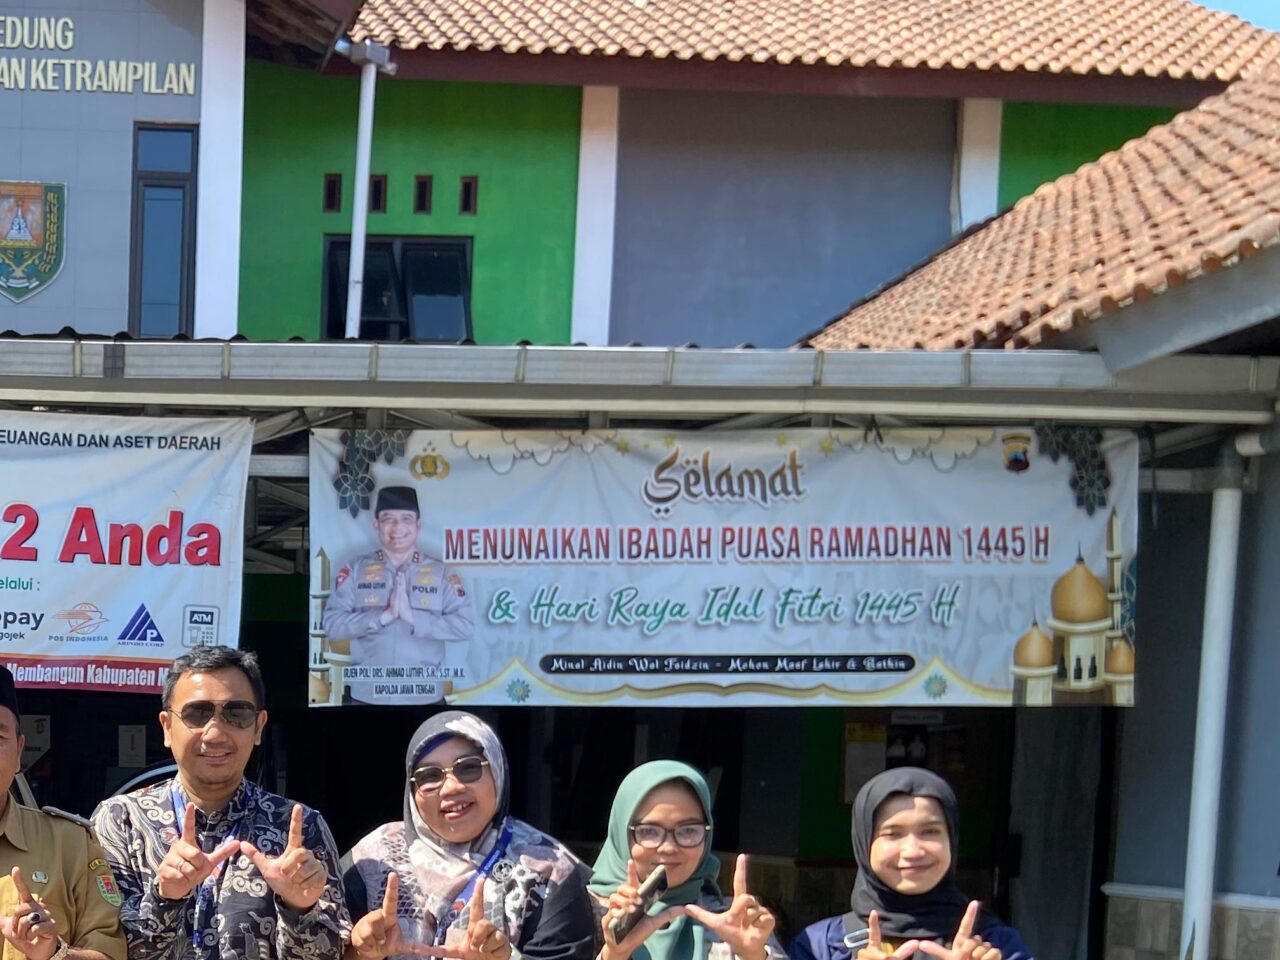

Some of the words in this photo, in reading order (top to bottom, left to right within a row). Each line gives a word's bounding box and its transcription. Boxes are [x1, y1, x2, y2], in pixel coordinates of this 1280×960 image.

[30, 58, 196, 95] KETRAMPILAN
[77, 433, 109, 449] DAN
[113, 435, 153, 449] ASET
[157, 436, 221, 450] DAERAH
[57, 506, 221, 567] Anda
[444, 527, 610, 562] MENUNAIKAN
[619, 528, 712, 561] IBADAH
[721, 526, 801, 560] PUASA
[809, 526, 952, 559] RAMADHAN
[962, 526, 1026, 558] 1445
[1032, 526, 1050, 558] H
[412, 585, 438, 594] POLRI
[191, 613, 212, 623] ATM
[490, 592, 517, 623] &
[531, 586, 598, 623] Hari
[610, 586, 690, 633] Raya
[698, 586, 764, 624] Idul
[776, 587, 845, 626] Fitri
[856, 590, 922, 624] 1445
[932, 584, 959, 626] H
[87, 664, 153, 686] Kabupaten
[375, 684, 400, 695] KAPOLDA
[400, 684, 414, 695] JAWA
[415, 684, 435, 695] TENGAH
